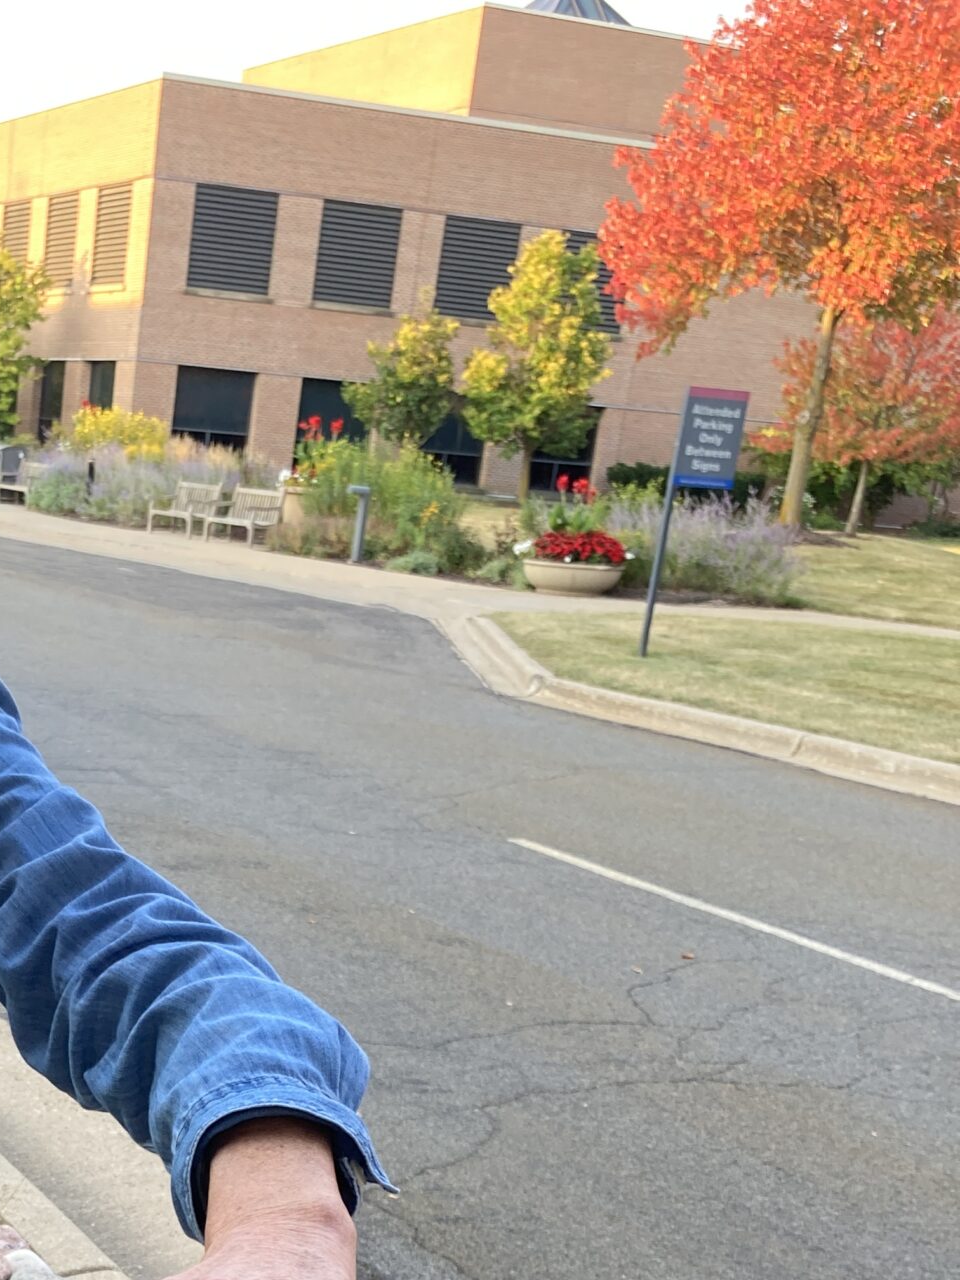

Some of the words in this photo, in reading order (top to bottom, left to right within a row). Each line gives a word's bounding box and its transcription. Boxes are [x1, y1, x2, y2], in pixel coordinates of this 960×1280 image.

[691, 404, 741, 419] Attended
[693, 417, 734, 434] Parking
[699, 432, 724, 447] Only
[685, 445, 731, 459] Between
[691, 459, 721, 473] Signs
